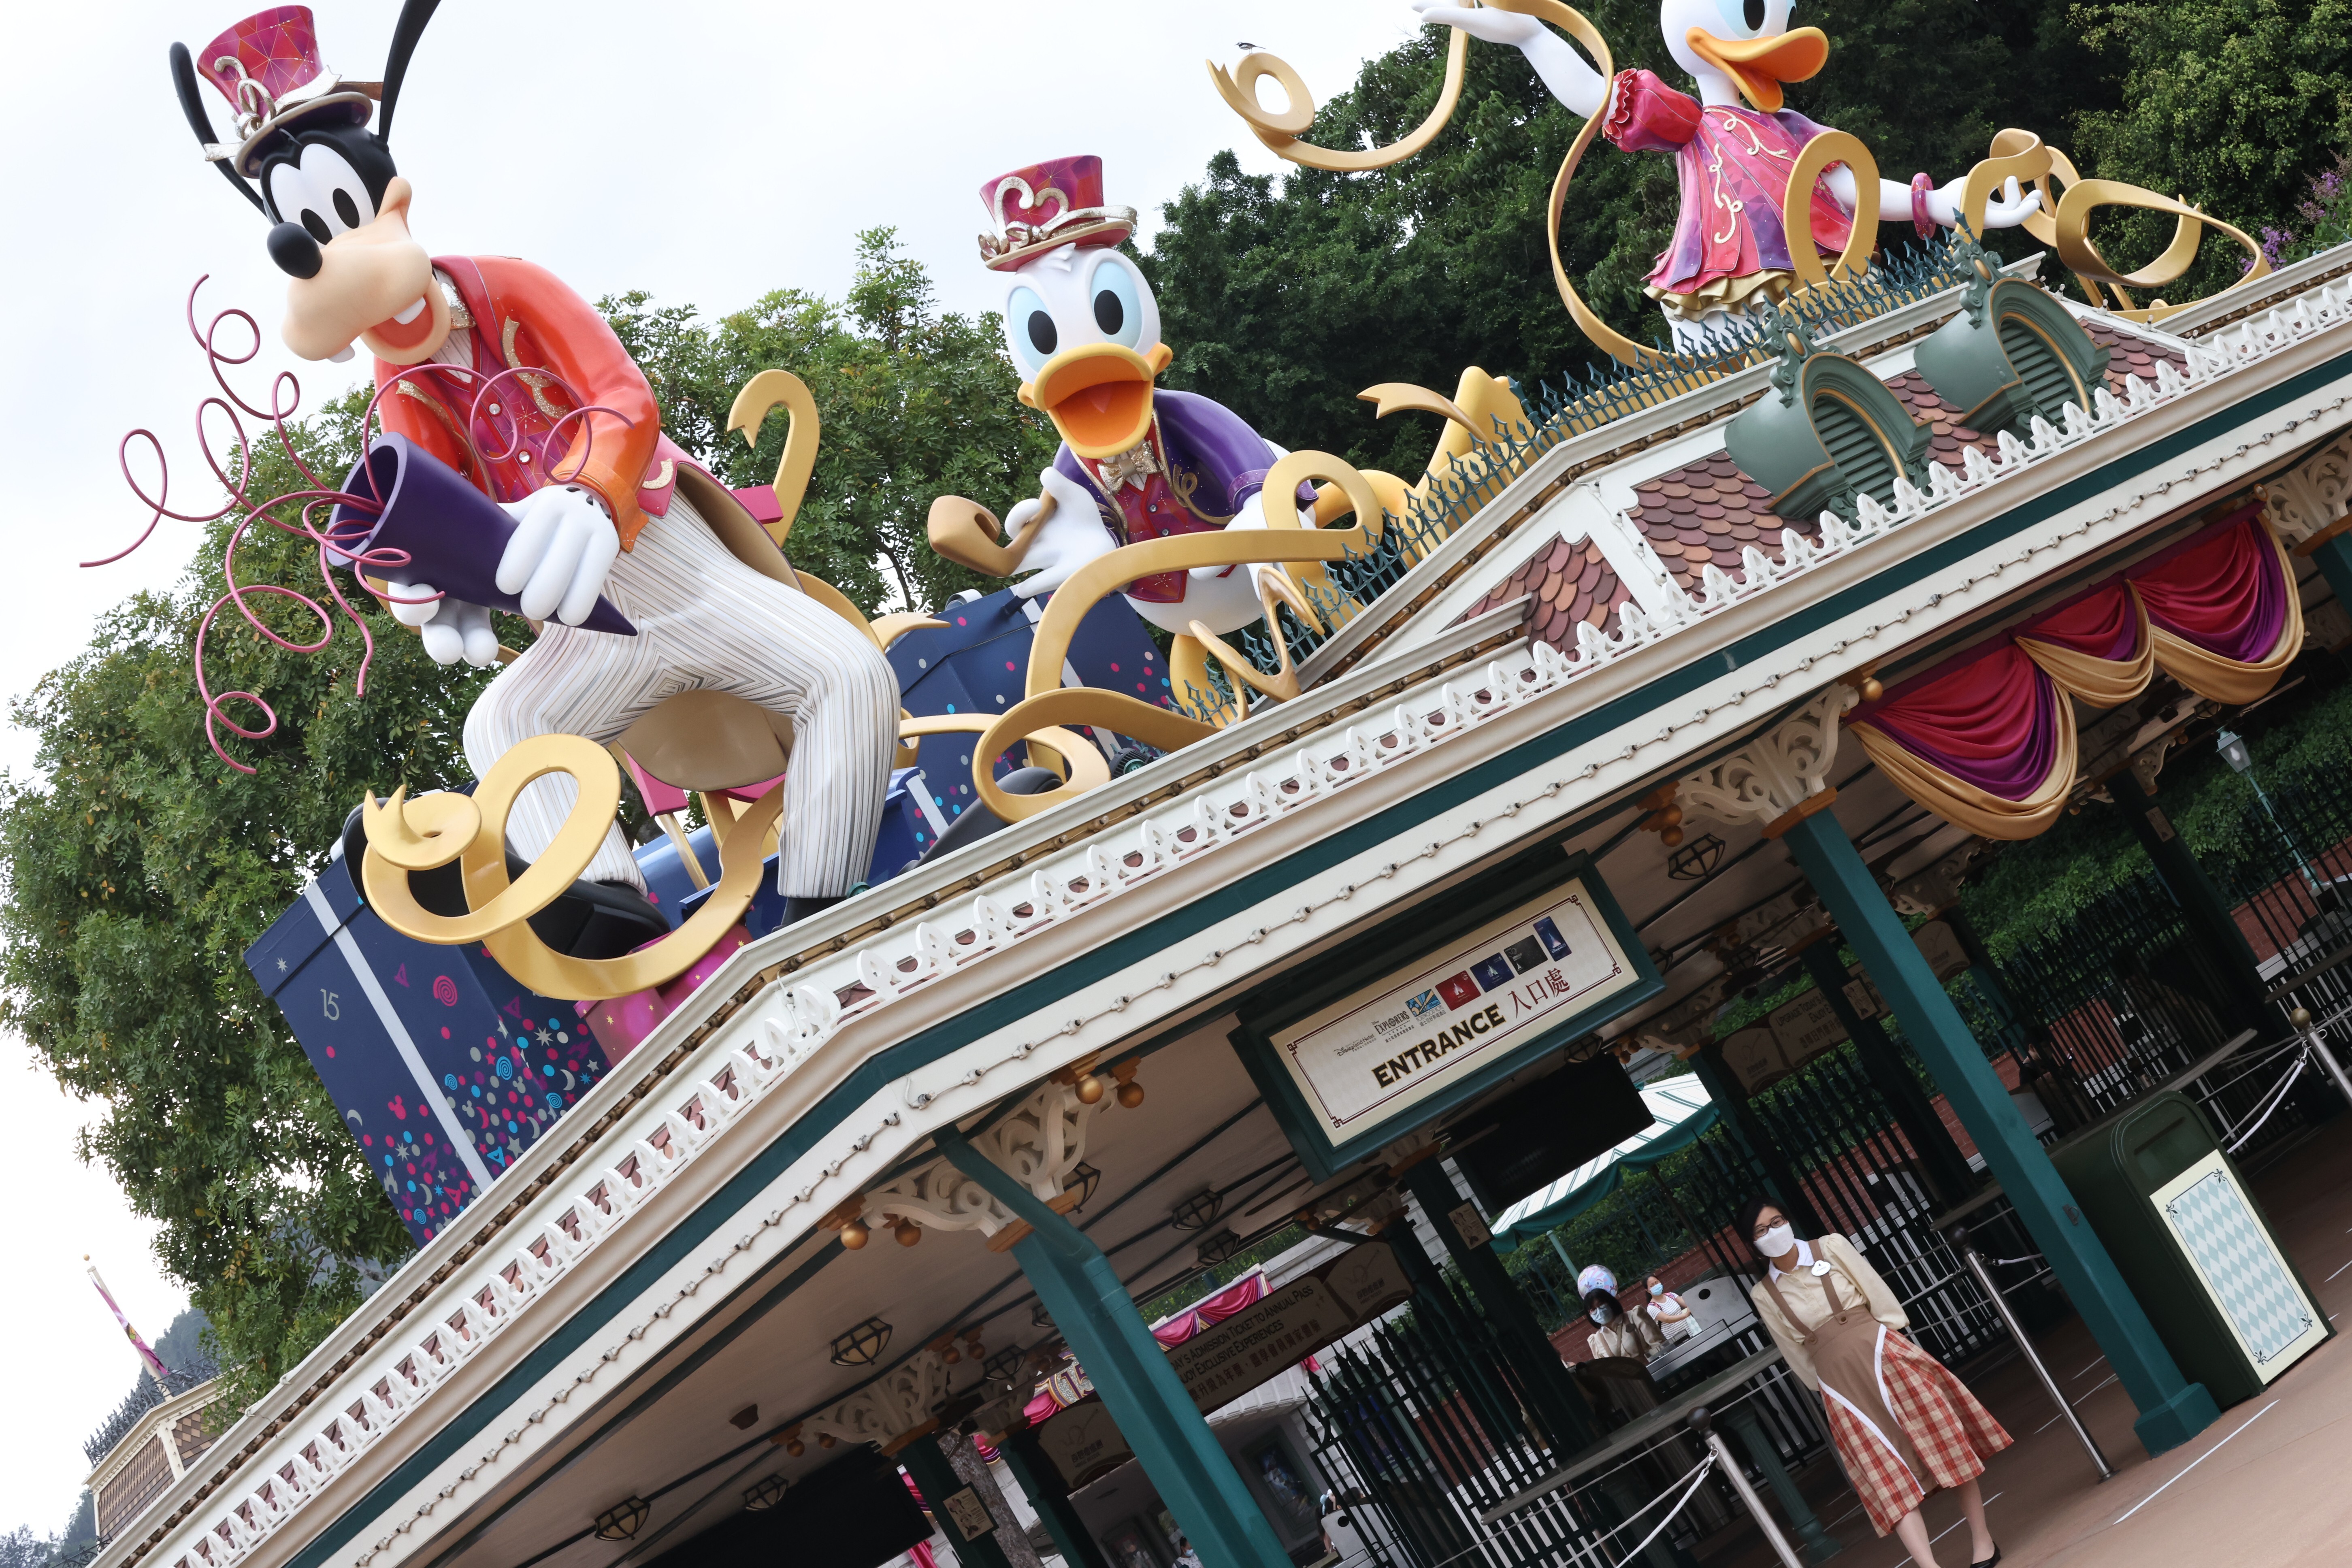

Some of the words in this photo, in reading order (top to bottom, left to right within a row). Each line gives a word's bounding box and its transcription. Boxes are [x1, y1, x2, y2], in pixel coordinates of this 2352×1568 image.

[320, 989, 340, 1020] 15
[1775, 1007, 1802, 1026] UPGRADE
[1371, 1002, 1506, 1089] ENTRANCE
[1507, 967, 1570, 1018] 入口處
[1374, 1010, 1410, 1034] EXPLORERS
[1362, 1033, 1375, 1043] Hotel
[1190, 1332, 1231, 1360] ADMISSION
[1227, 1317, 1255, 1338] TICKET
[1253, 1312, 1266, 1324] TO
[1264, 1295, 1295, 1319] ANNUAL
[1292, 1285, 1314, 1302] PASS
[1194, 1346, 1236, 1375] EXCLUSIVE
[1233, 1319, 1285, 1353] EXPERIENCES
